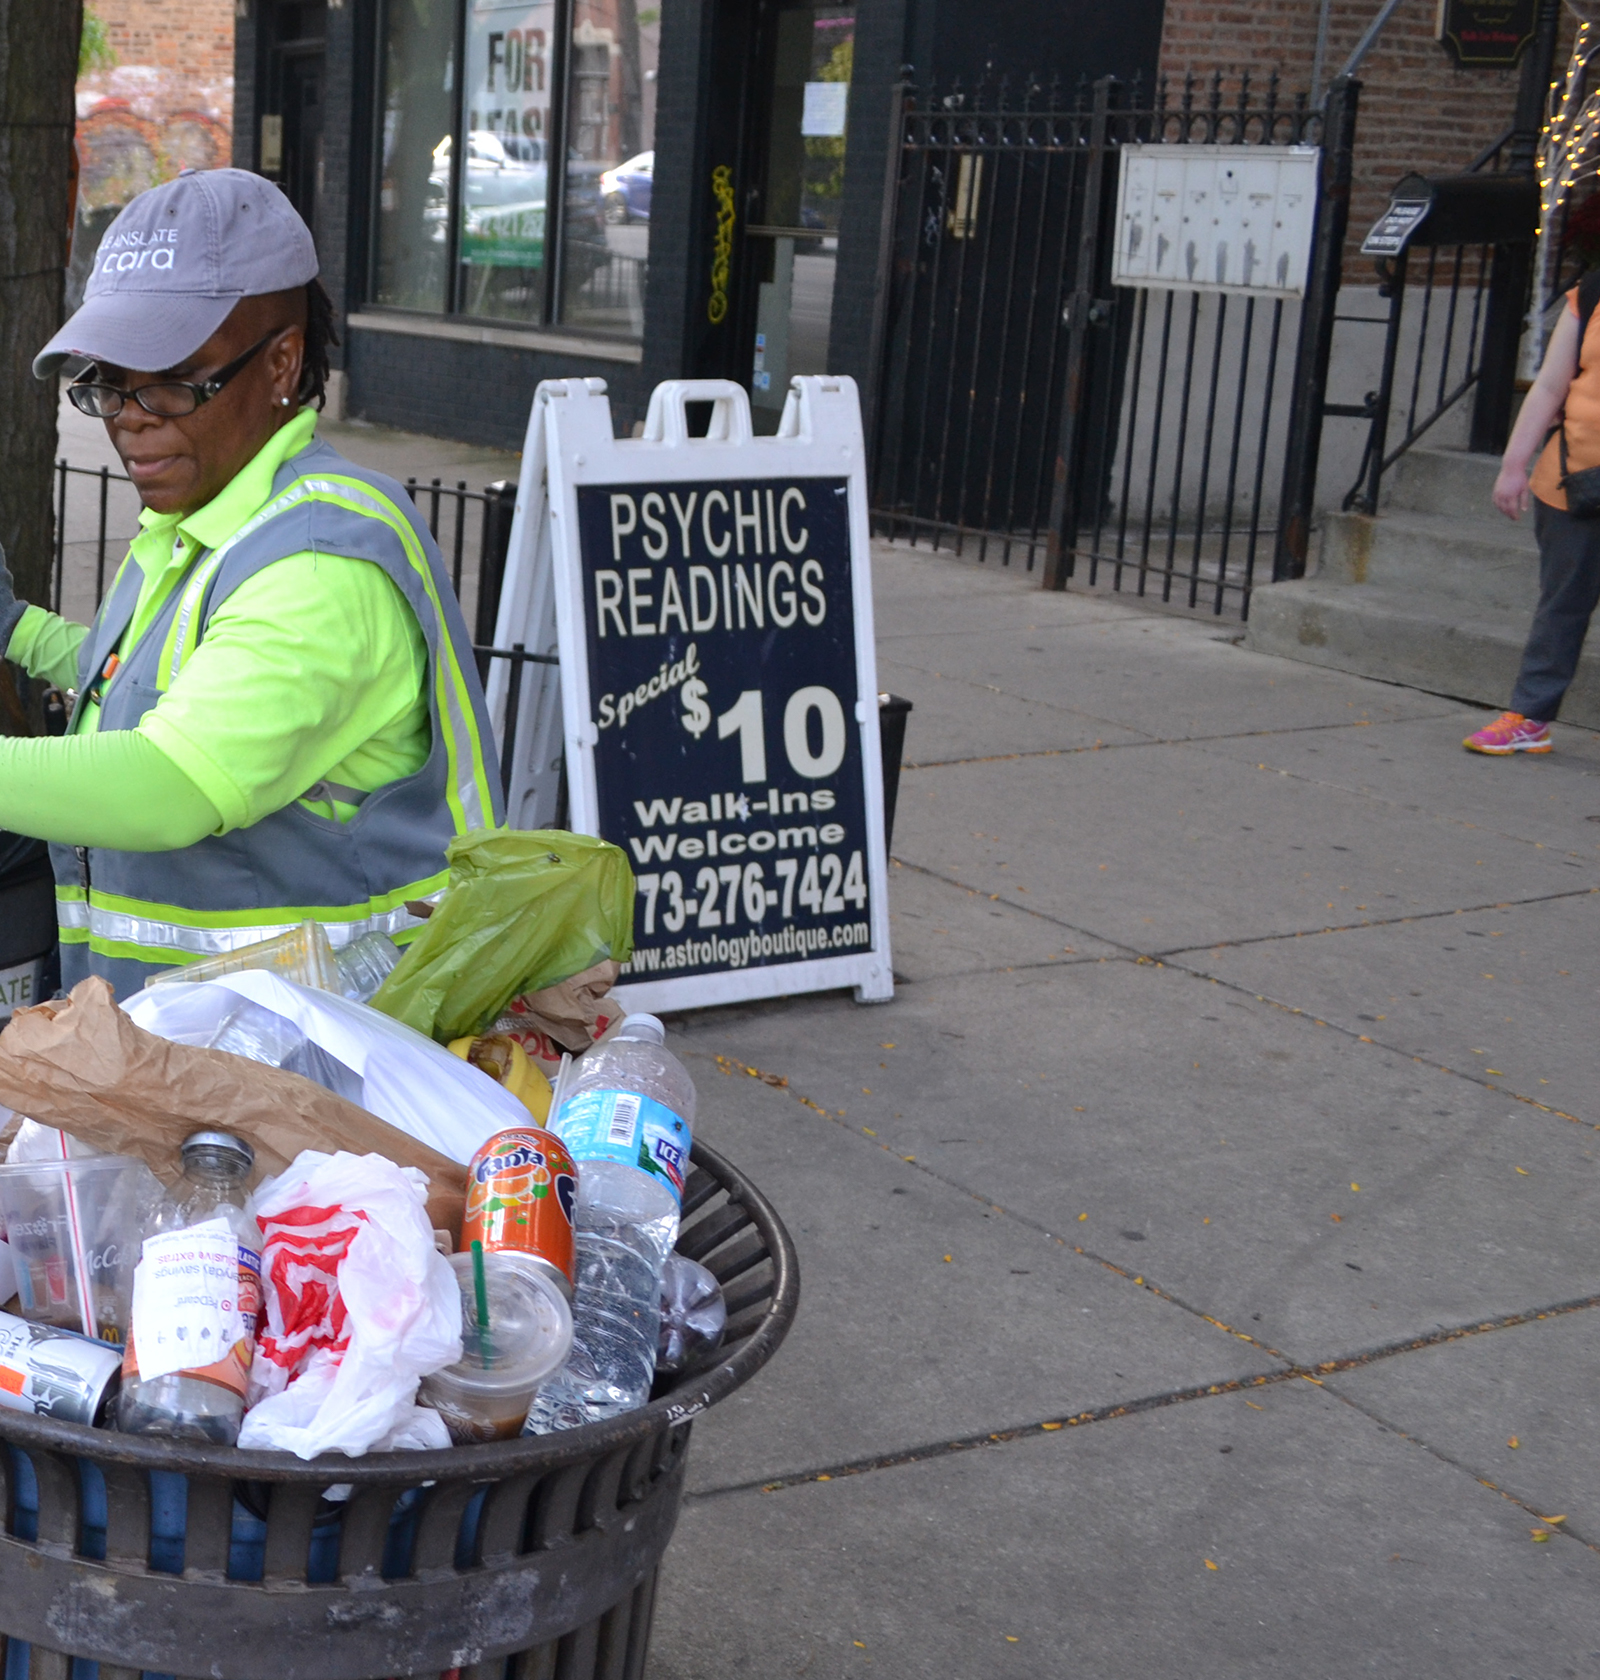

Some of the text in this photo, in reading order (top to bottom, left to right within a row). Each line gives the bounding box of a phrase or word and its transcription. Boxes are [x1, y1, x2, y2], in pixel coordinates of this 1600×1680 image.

[486, 27, 546, 94] FOR
[100, 228, 179, 250] LEANSLATE
[102, 247, 176, 273] cara
[610, 487, 809, 561] PSYCHIC
[595, 559, 827, 637] READINGS
[598, 642, 847, 784] Special $10
[633, 788, 838, 828] Walk-Ins
[629, 822, 846, 865] Welcome
[633, 850, 868, 935] 73-276-7424
[476, 1146, 547, 1184] Fanta
[658, 1140, 680, 1166] ICE
